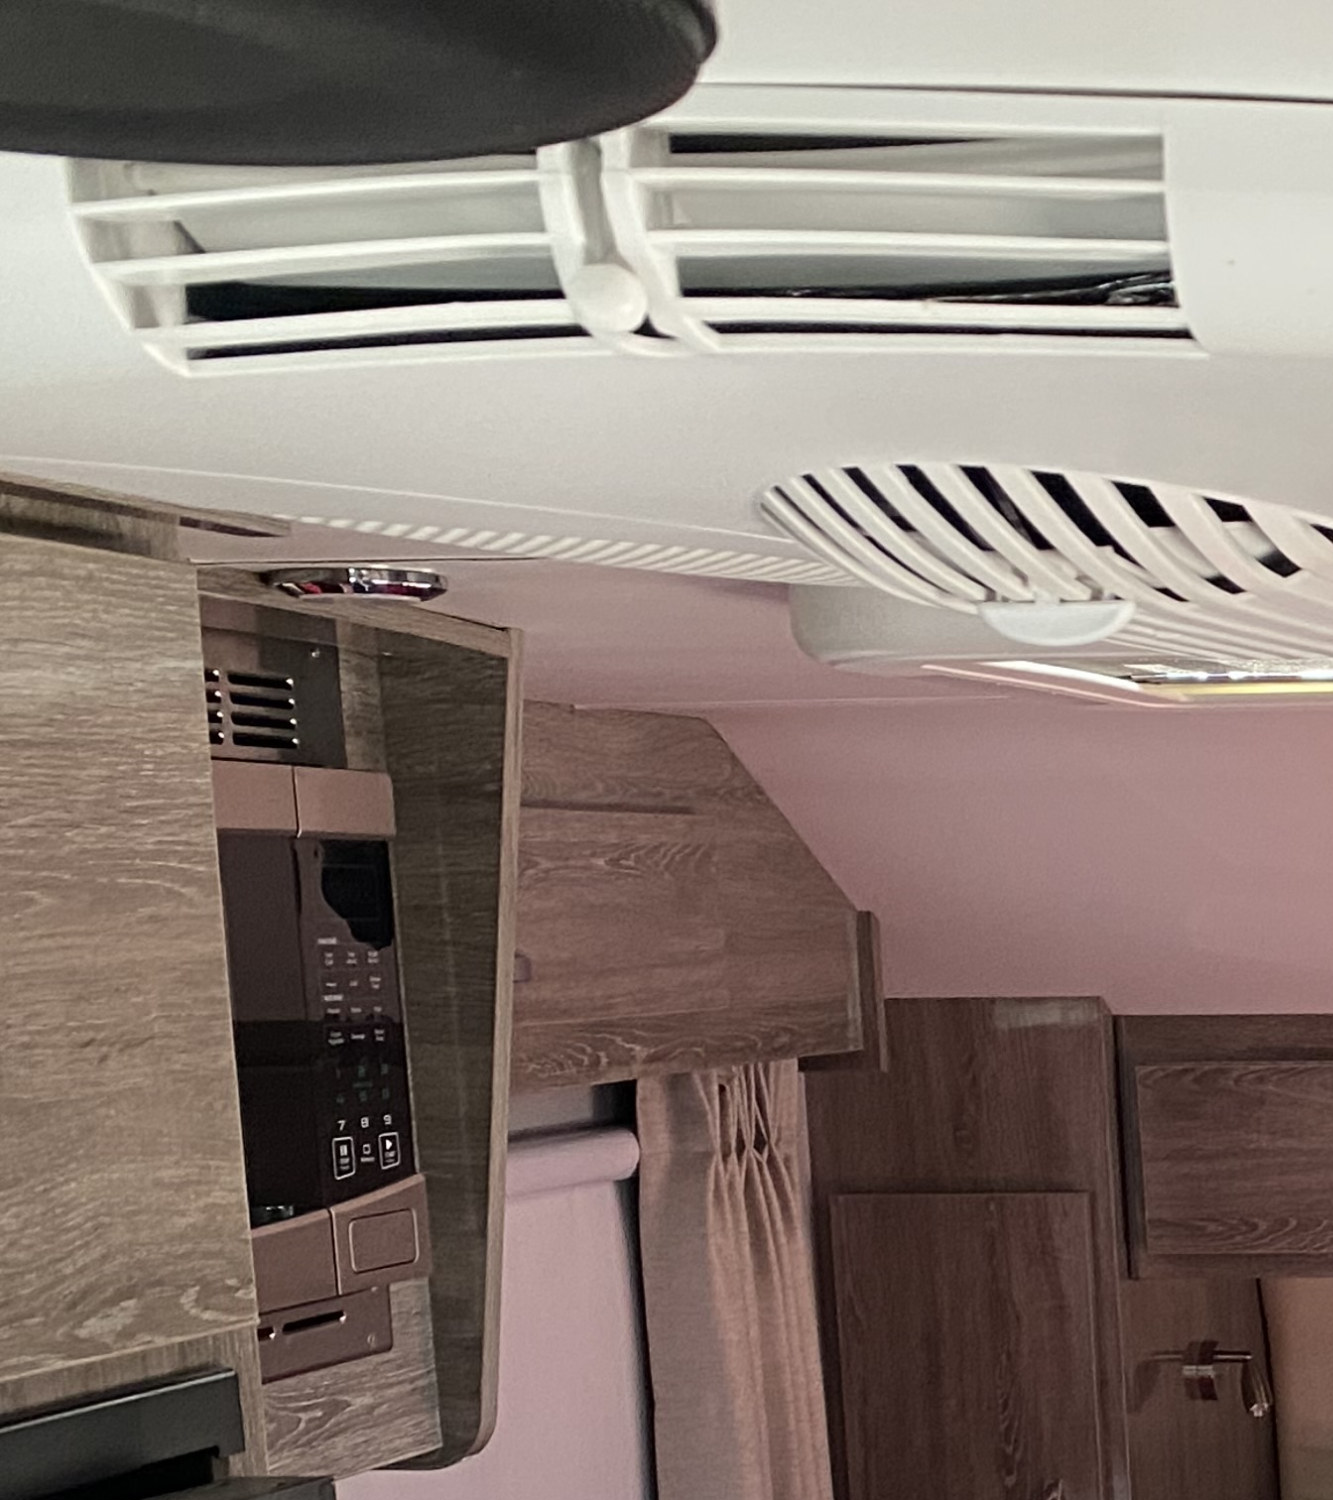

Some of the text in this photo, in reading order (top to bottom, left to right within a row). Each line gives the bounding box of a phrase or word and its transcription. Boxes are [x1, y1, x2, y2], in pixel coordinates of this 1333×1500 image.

[337, 1114, 392, 1131] 7 8 9
